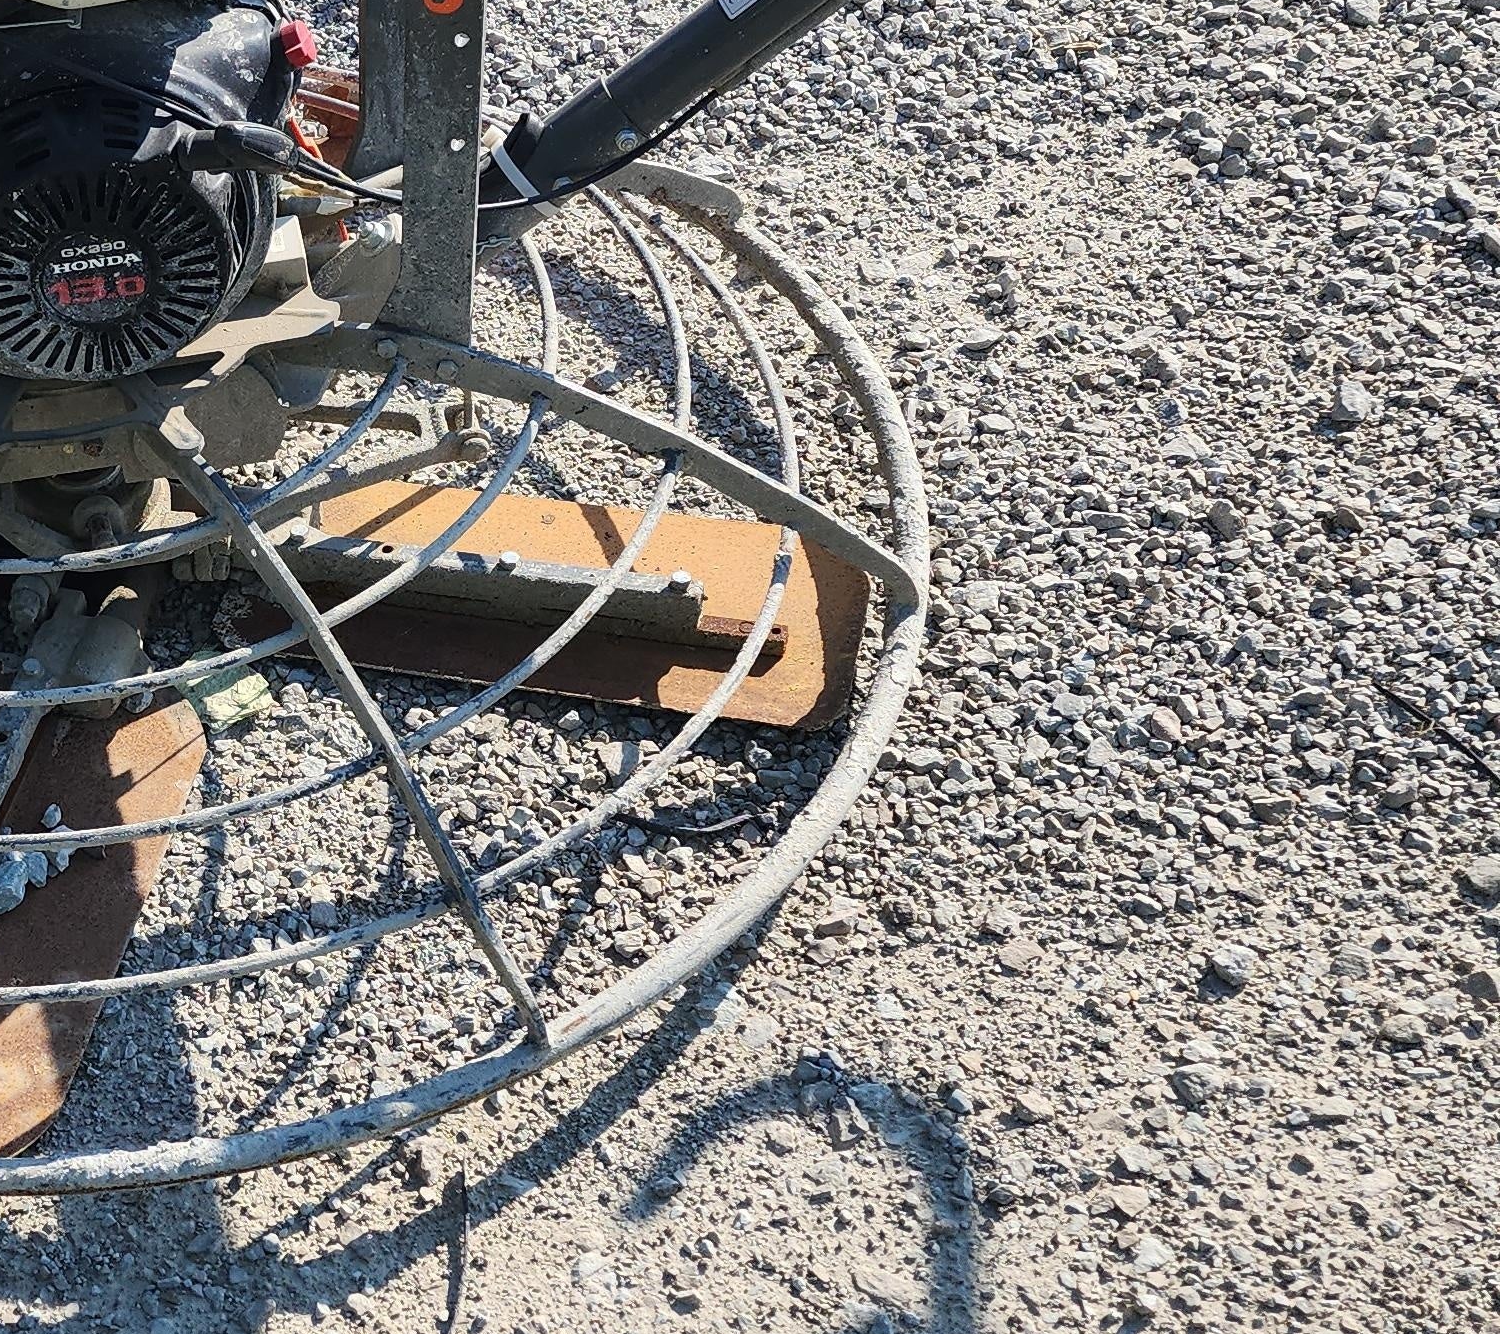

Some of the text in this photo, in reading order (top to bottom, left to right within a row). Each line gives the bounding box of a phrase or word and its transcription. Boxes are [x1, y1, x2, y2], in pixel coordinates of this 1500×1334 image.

[61, 240, 126, 258] GX390
[51, 252, 142, 275] HONDA
[46, 275, 145, 305] 13.0
